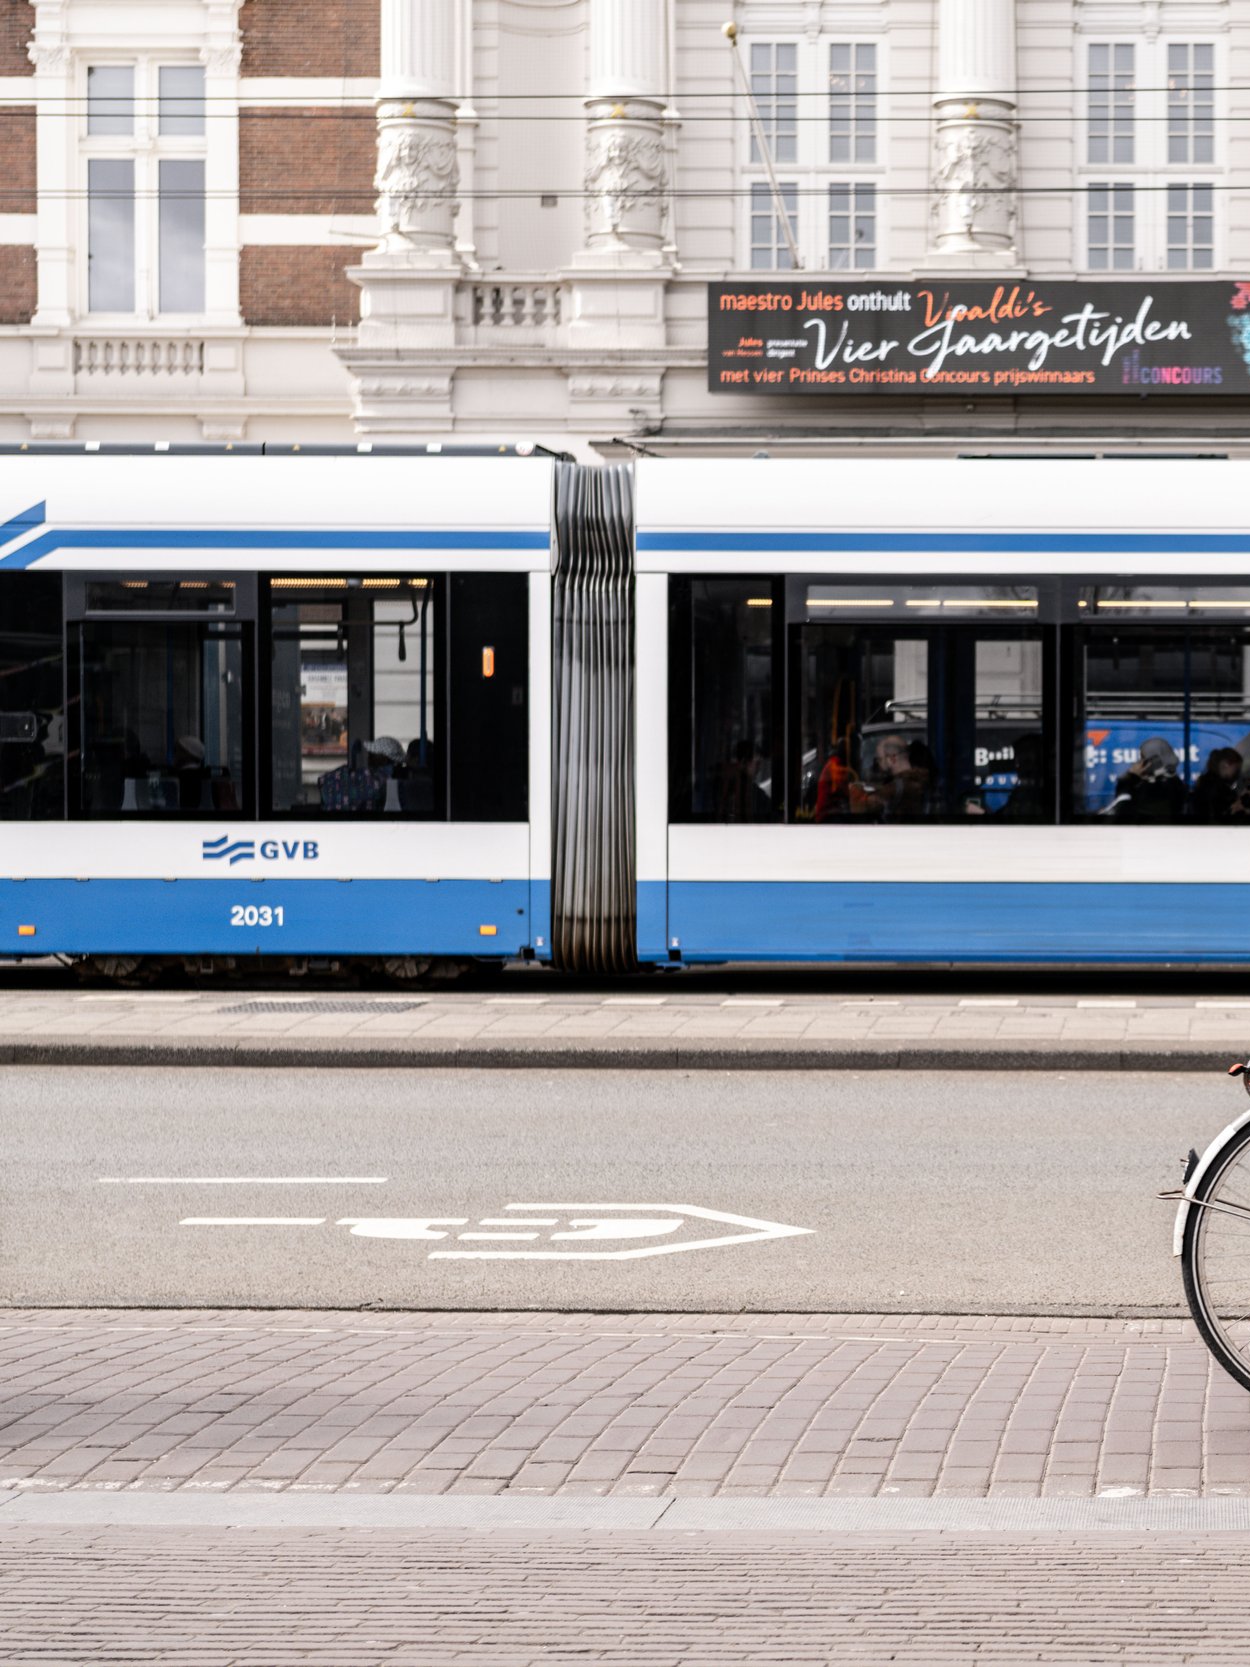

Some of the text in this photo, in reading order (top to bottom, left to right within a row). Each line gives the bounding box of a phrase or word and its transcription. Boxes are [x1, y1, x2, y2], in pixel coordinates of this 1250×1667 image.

[720, 291, 792, 312] maestro
[797, 290, 843, 312] Jules
[847, 290, 911, 312] onthult
[803, 318, 900, 370] Vier
[907, 296, 1193, 379] Jaargetijden
[720, 367, 1095, 387] met vier Prinses Christina Concours prijswinnaars
[1141, 366, 1222, 385] CONCOURS
[260, 840, 319, 860] GVB
[230, 905, 284, 926] 2031
